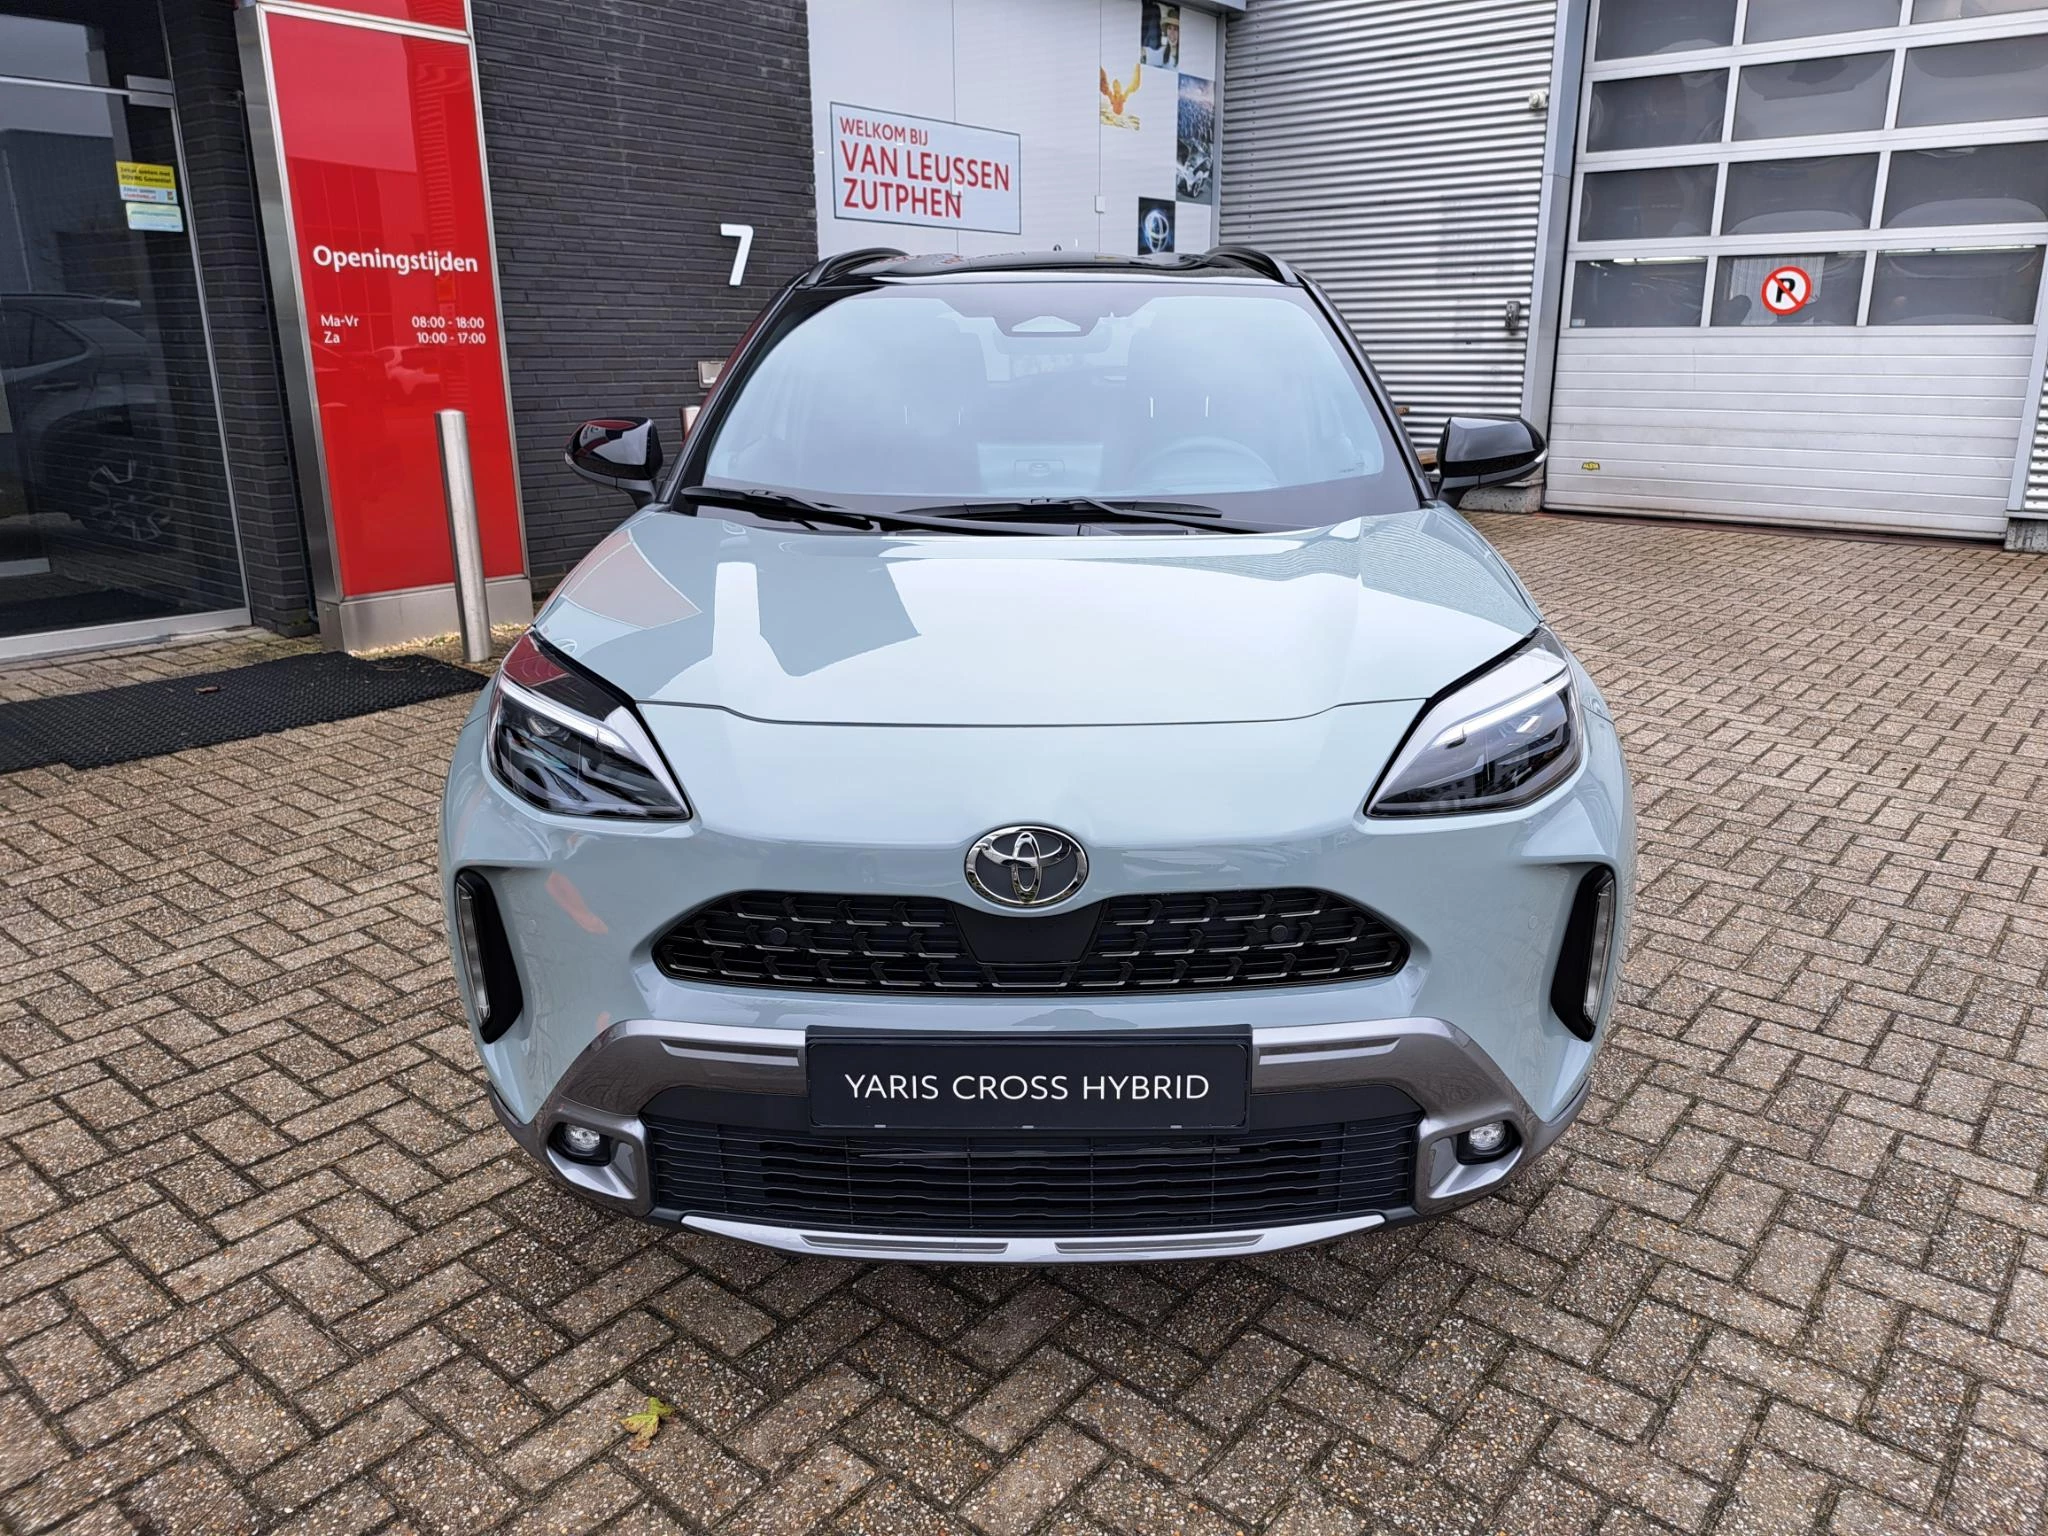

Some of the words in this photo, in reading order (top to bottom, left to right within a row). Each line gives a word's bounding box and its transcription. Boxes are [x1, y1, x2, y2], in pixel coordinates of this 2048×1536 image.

[839, 116, 906, 143] WELKOM
[909, 128, 929, 147] BIJ
[840, 140, 899, 178] VAN
[906, 150, 1010, 192] LEUSSEN
[842, 177, 963, 219] ZUTPHEN
[313, 245, 478, 276] Openingstijden
[720, 223, 754, 287] 7
[320, 314, 360, 328] Ma-Vr
[411, 316, 446, 329] 08:00
[455, 316, 485, 329] 18:00
[324, 331, 341, 344] Za
[416, 332, 447, 344] 10:00
[457, 332, 486, 344] 17:00
[844, 1074, 939, 1100] YARIS
[952, 1074, 1069, 1101] CROSS
[1082, 1074, 1210, 1100] HYBRID
